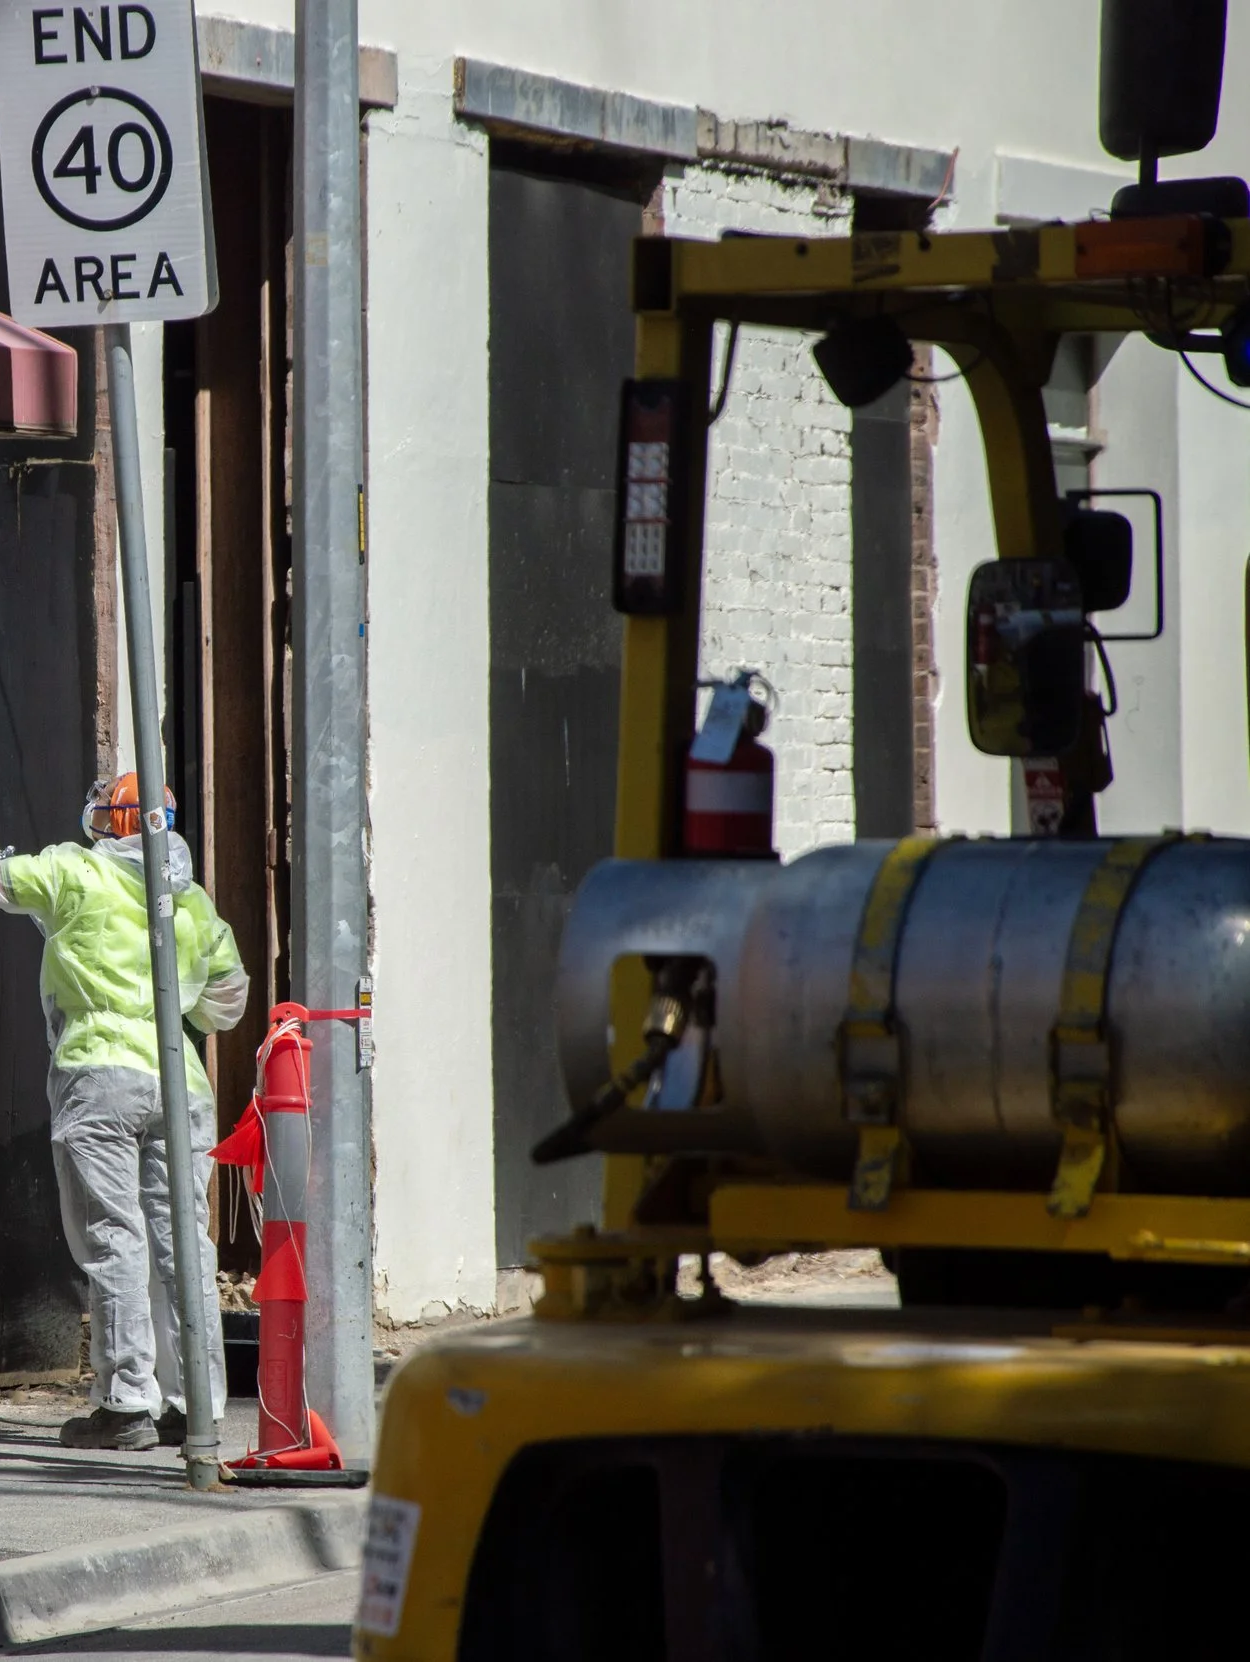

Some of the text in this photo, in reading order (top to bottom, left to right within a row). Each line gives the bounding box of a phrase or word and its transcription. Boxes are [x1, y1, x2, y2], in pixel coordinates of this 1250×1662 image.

[32, 4, 156, 65] END
[52, 121, 156, 195] 40
[33, 251, 184, 305] AREA
